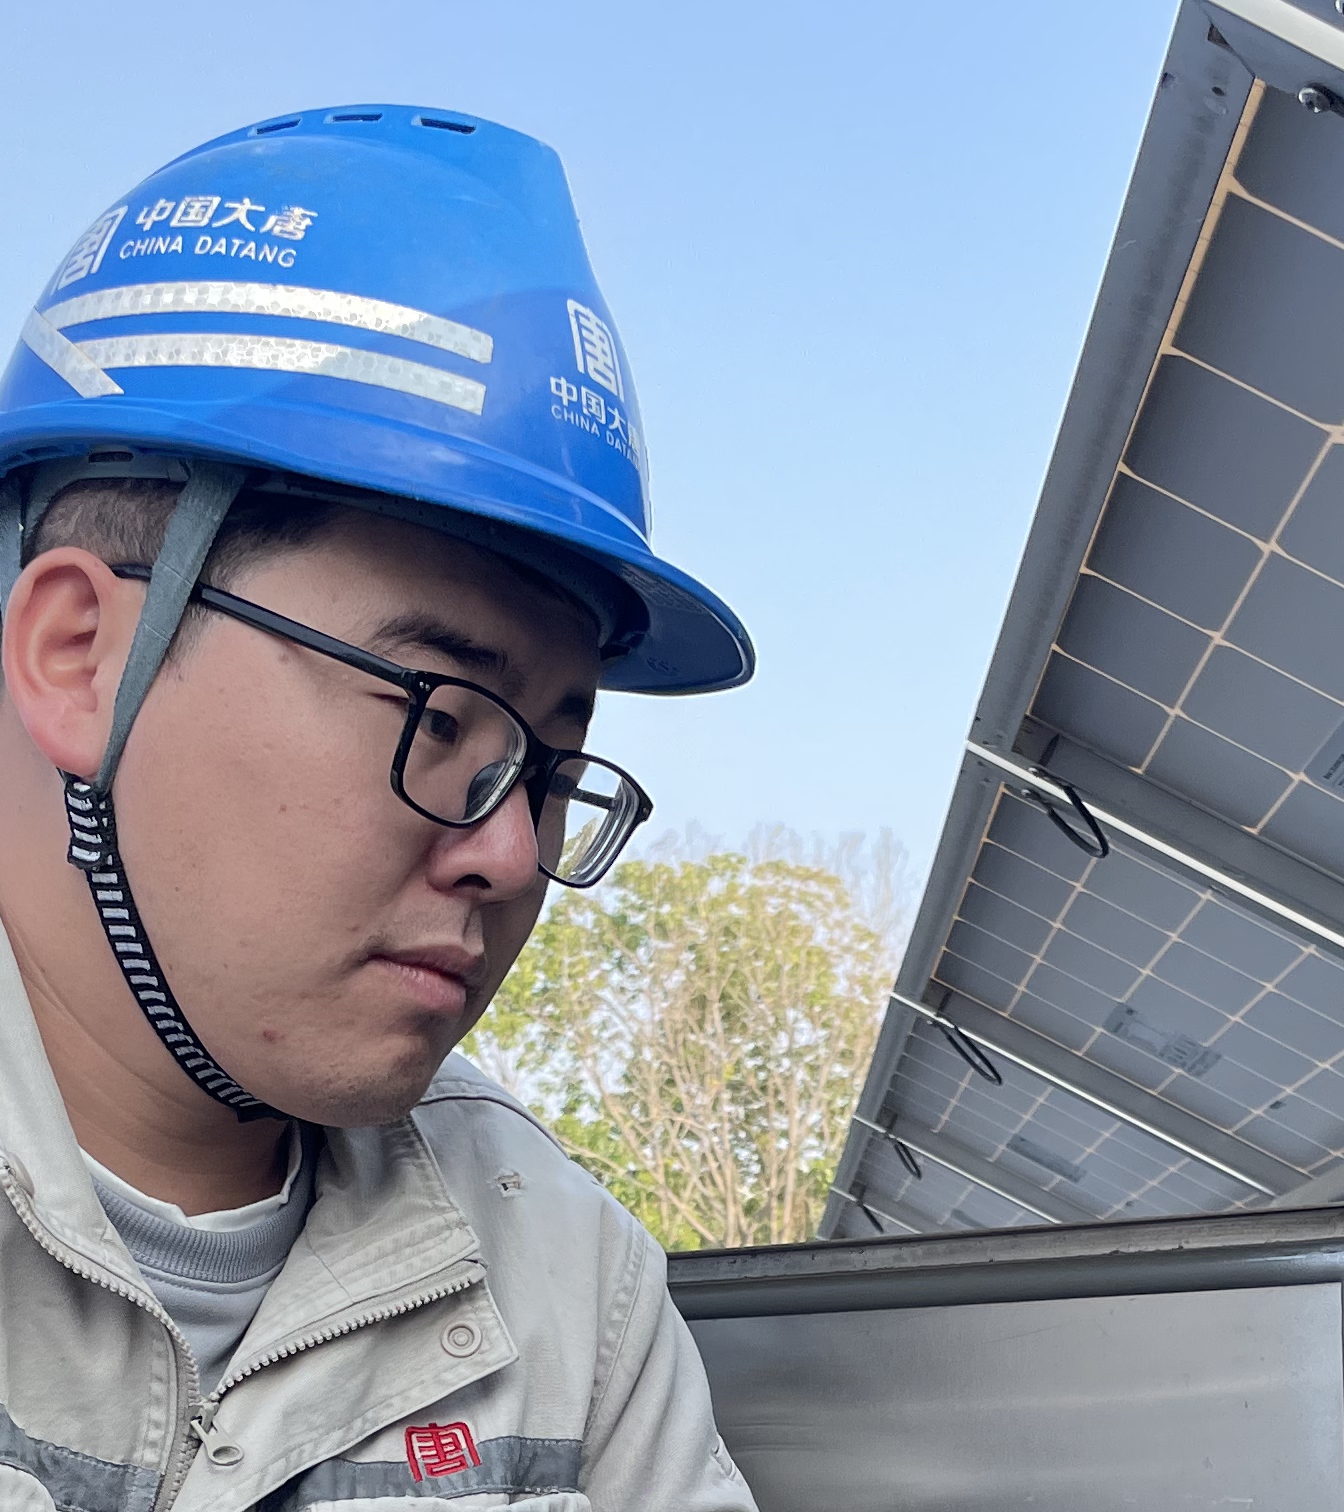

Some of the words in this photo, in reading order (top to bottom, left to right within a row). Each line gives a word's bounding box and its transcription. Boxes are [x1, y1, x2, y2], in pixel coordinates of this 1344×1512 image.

[136, 196, 318, 241] 中国大唐
[119, 236, 183, 260] CHINA
[194, 235, 297, 269] DATANG
[551, 404, 601, 438] CHINA
